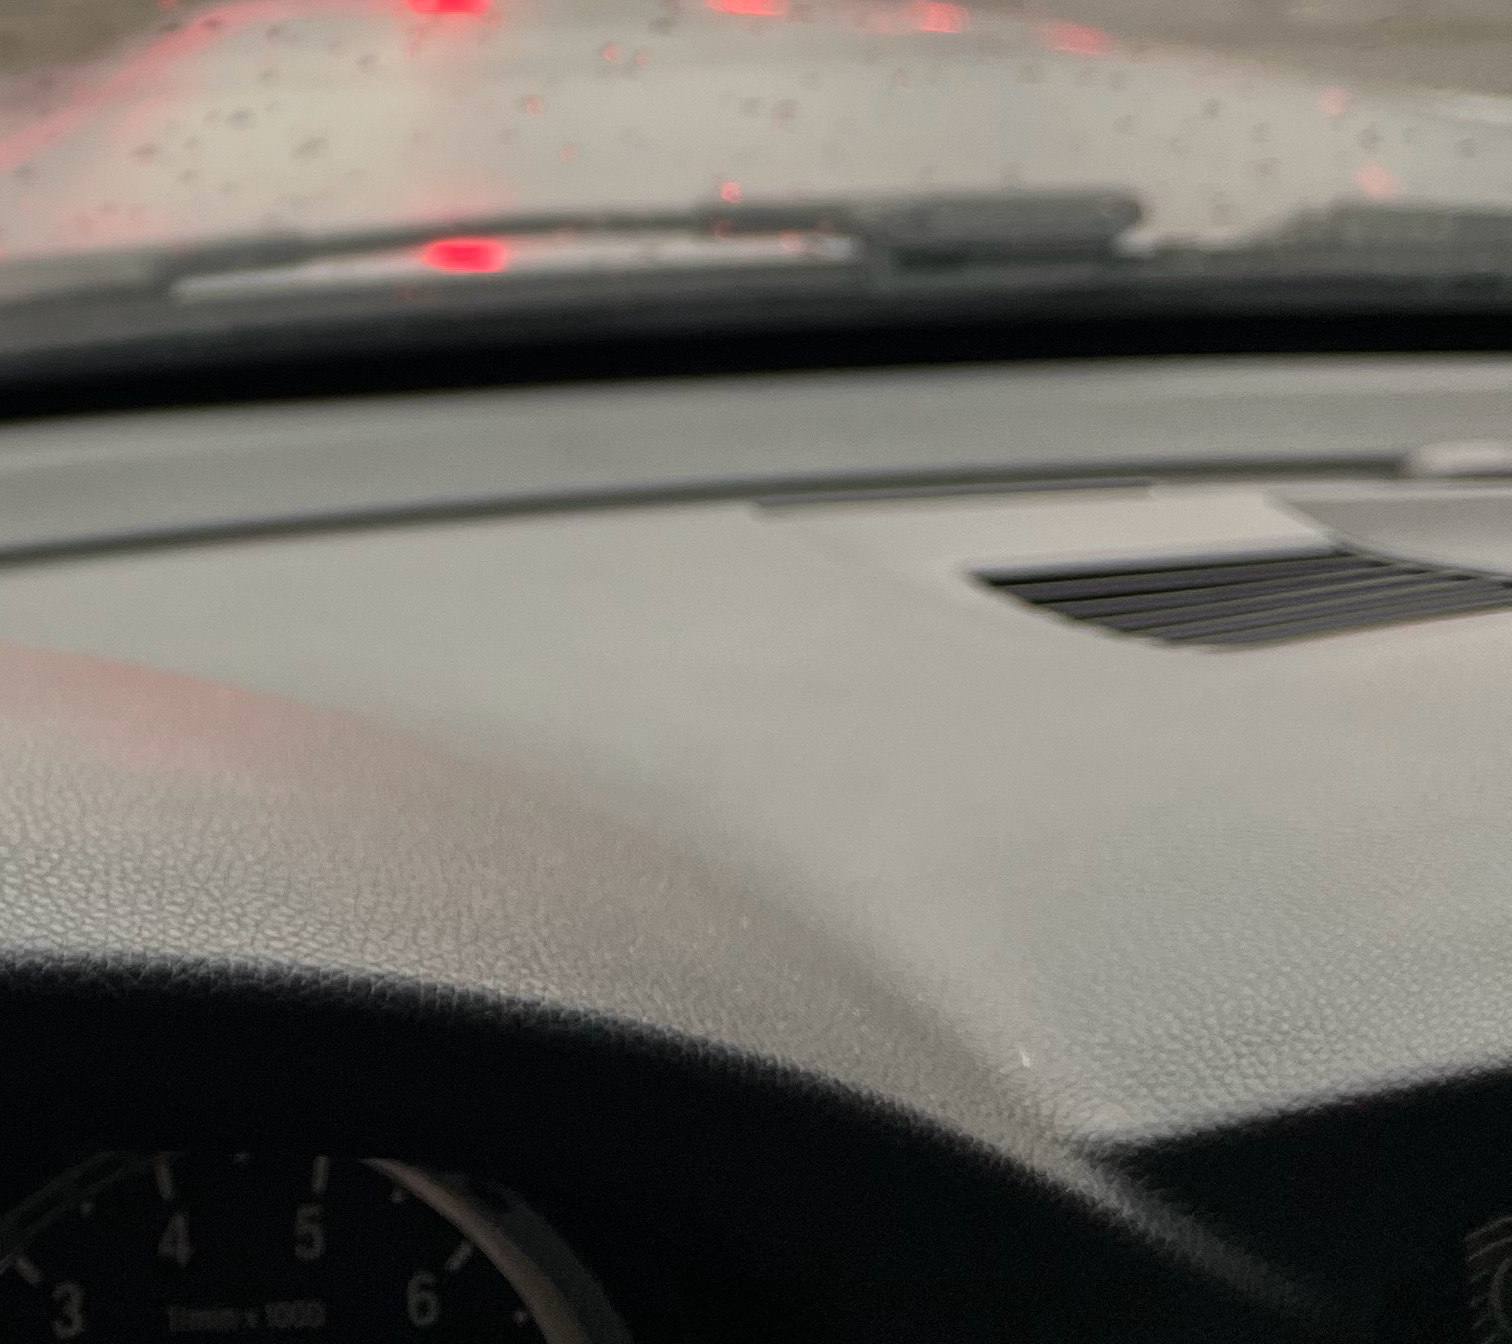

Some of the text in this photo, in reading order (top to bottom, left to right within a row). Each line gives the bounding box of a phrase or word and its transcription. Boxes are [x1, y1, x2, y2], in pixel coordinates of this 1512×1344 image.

[295, 1201, 325, 1263] 5
[51, 1279, 86, 1340] 3
[406, 1269, 441, 1327] 6
